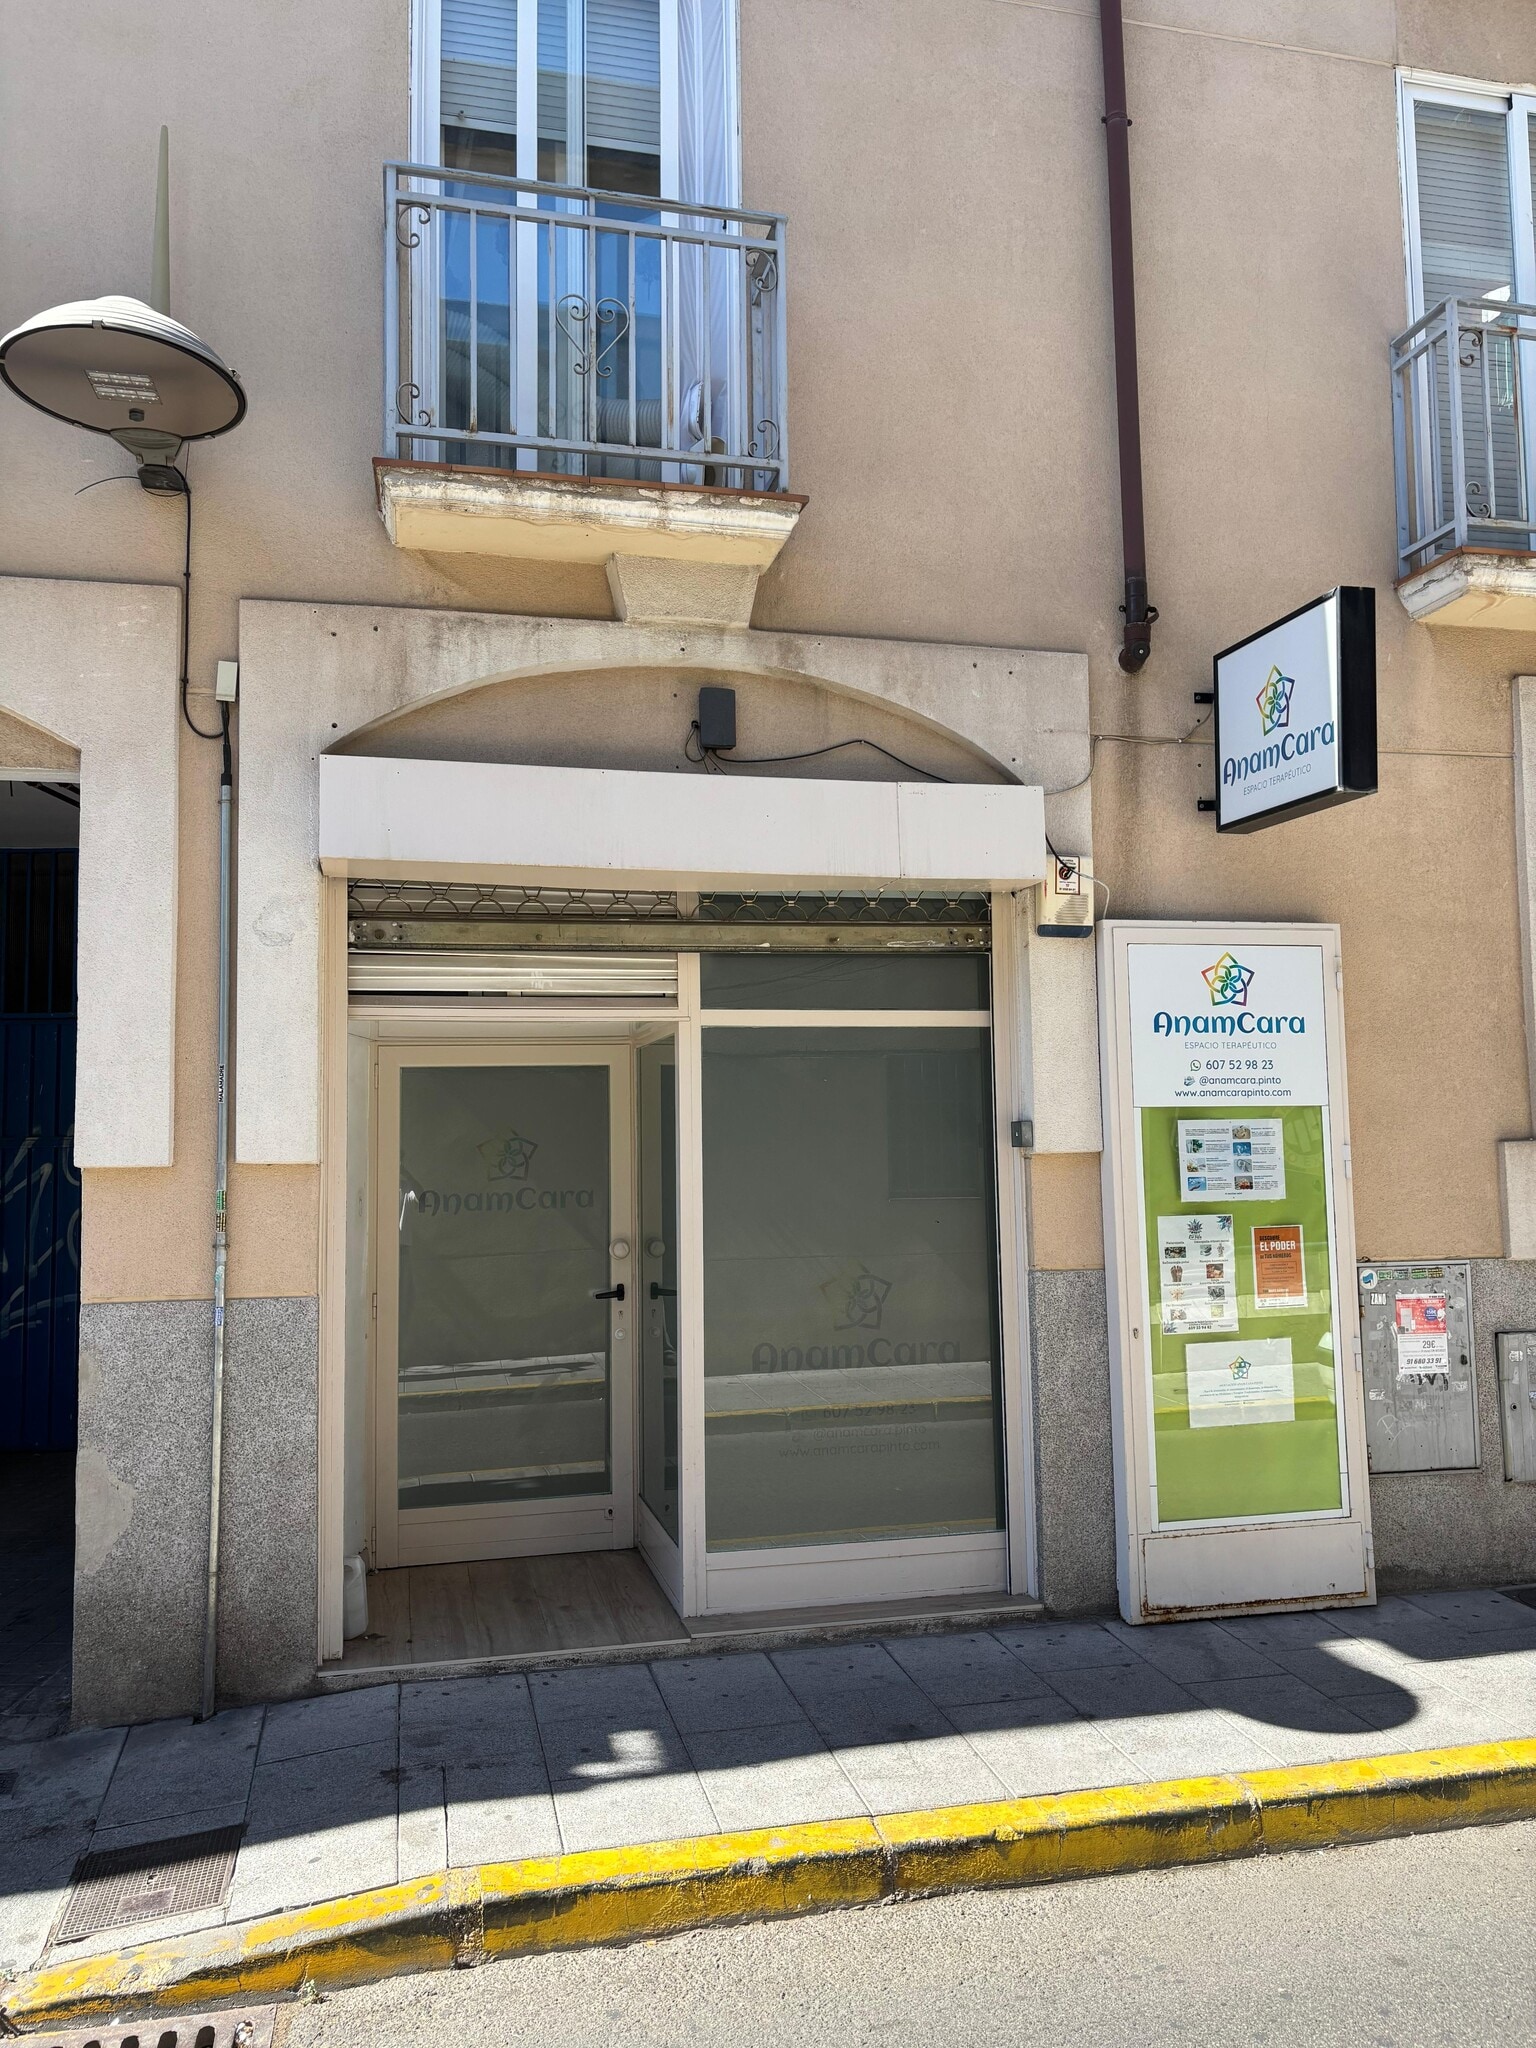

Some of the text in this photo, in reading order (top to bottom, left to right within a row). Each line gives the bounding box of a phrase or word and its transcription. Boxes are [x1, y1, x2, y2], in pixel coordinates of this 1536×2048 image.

[1224, 720, 1335, 787] AnamCara
[1243, 763, 1312, 796] ESPACIO TERAPÉUTICO
[1153, 1011, 1306, 1037] AnamCara
[1184, 1039, 1277, 1050] ESPACIO TERAPÉUTICO
[1205, 1059, 1274, 1070] 607 52 98 23
[1199, 1076, 1281, 1087] @anamcara.pinto
[1174, 1088, 1292, 1097] www.anamcarapinto.com
[418, 1187, 594, 1216] AnamCara
[1260, 1240, 1296, 1251] EL PODER
[752, 1338, 961, 1373] AnamCara
